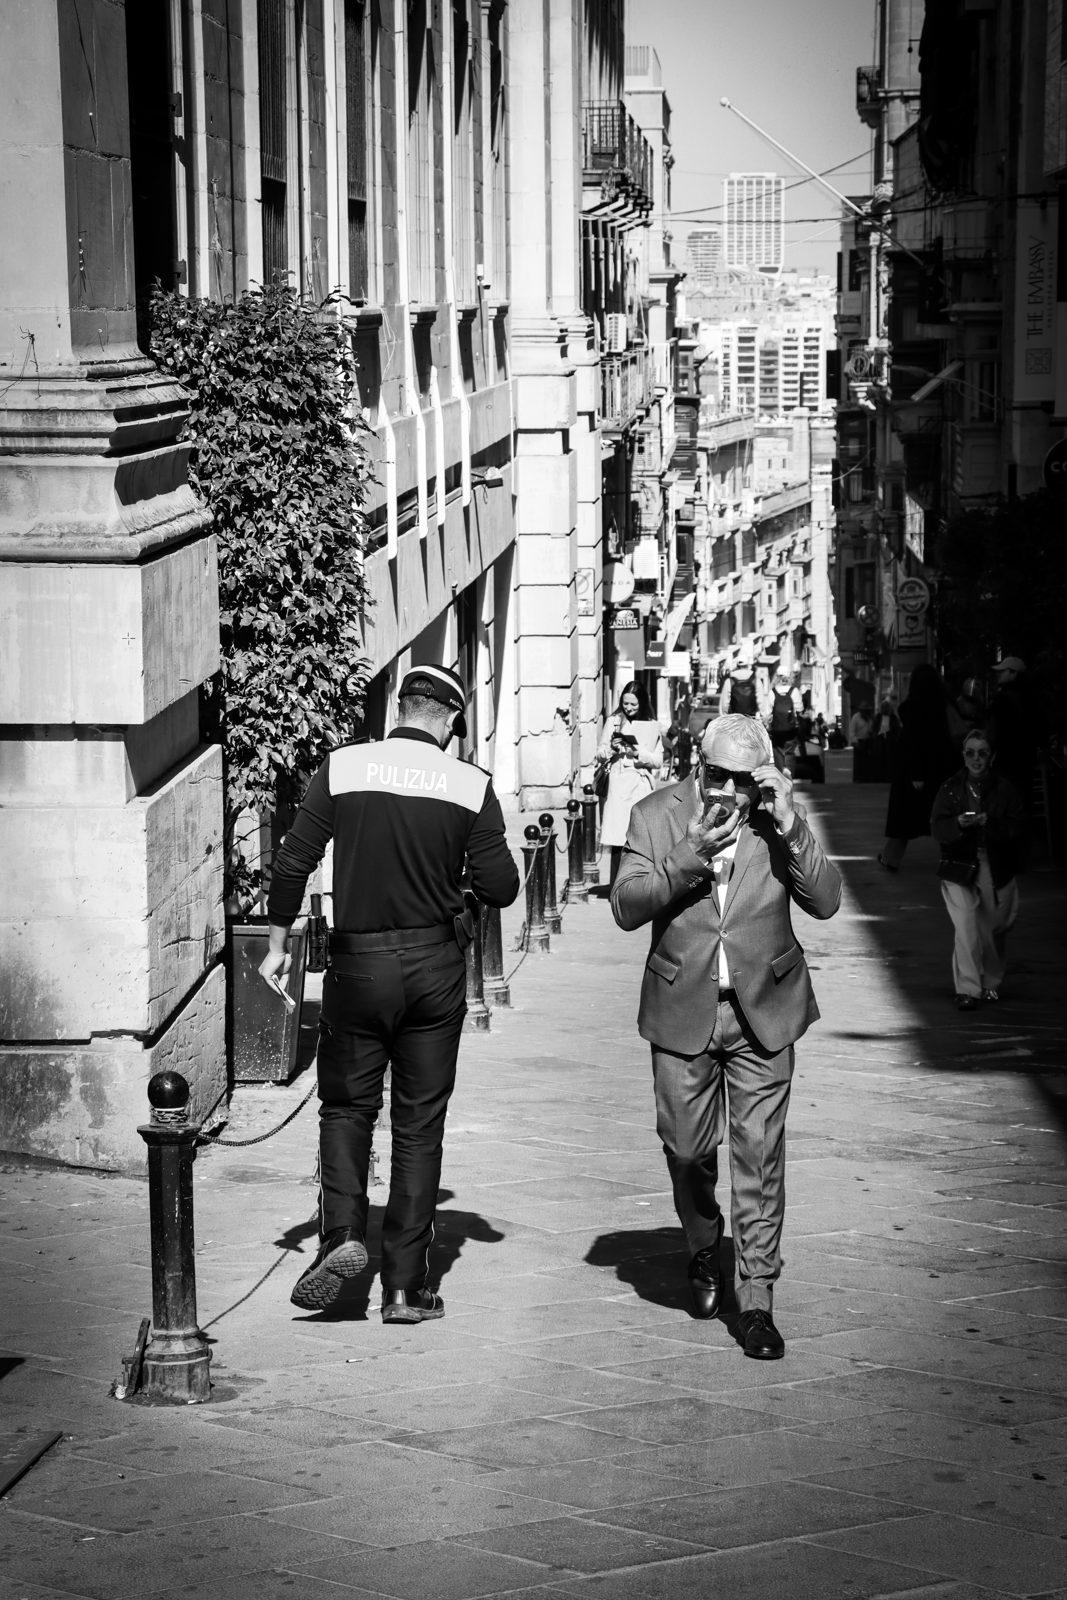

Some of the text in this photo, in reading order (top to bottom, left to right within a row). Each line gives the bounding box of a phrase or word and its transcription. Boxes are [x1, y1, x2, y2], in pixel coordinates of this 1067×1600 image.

[1026, 234, 1046, 340] THE EMBASSY
[366, 762, 448, 793] PULIZIJA
